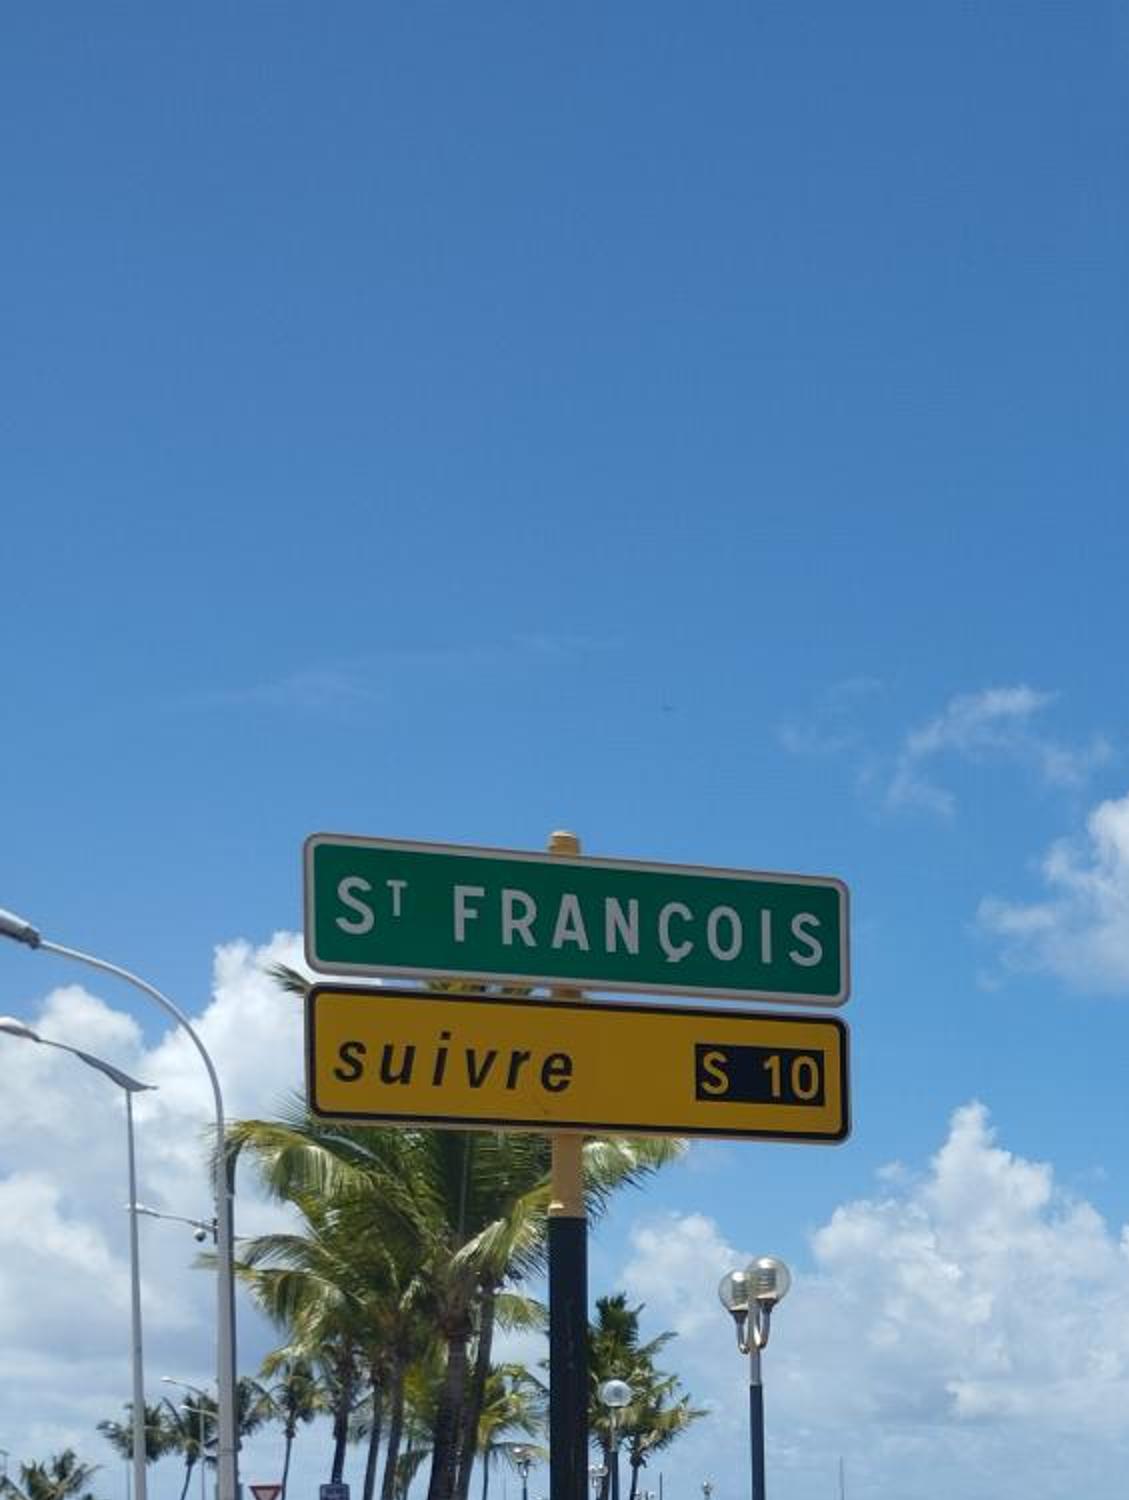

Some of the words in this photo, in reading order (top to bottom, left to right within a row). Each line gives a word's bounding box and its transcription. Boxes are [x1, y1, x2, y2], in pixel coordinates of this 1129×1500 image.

[452, 885, 823, 967] FRANÇOIS
[333, 1031, 574, 1093] suivre
[701, 1050, 730, 1096] S
[763, 1054, 820, 1100] 10
